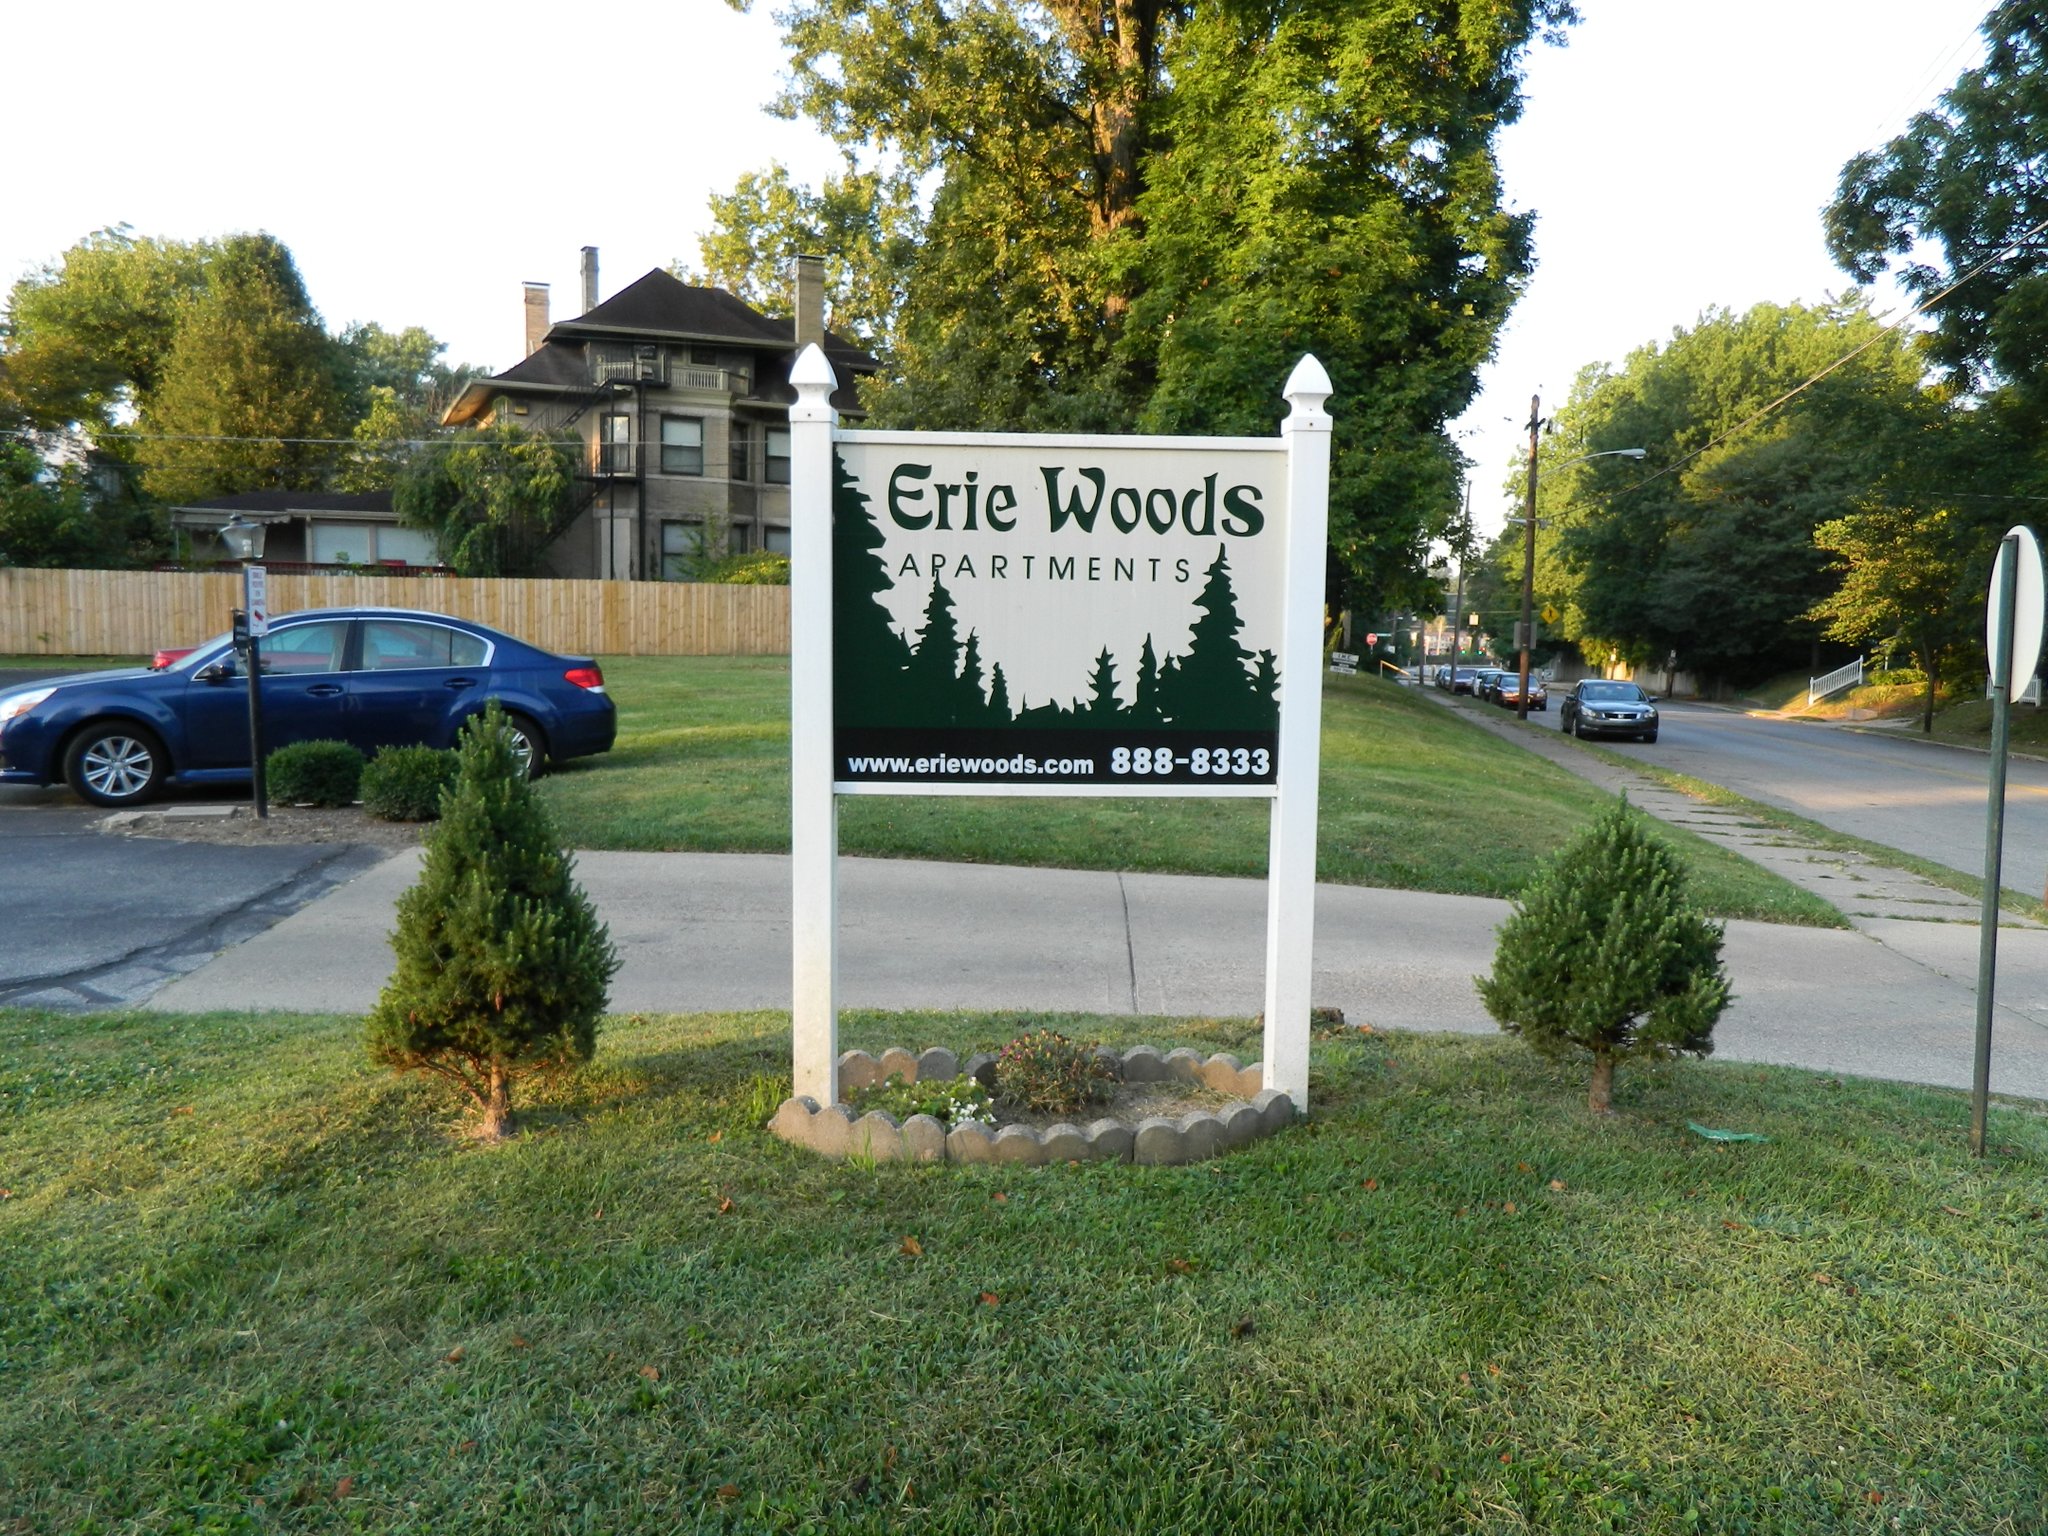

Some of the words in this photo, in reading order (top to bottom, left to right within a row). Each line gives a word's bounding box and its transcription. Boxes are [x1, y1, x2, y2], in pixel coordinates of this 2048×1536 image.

[888, 464, 1018, 532] Erie
[1040, 467, 1265, 537] Woods
[899, 553, 1190, 583] APARTMENTS
[848, 753, 1094, 775] www.eriewoods.com
[1110, 747, 1271, 776] 888-8333
